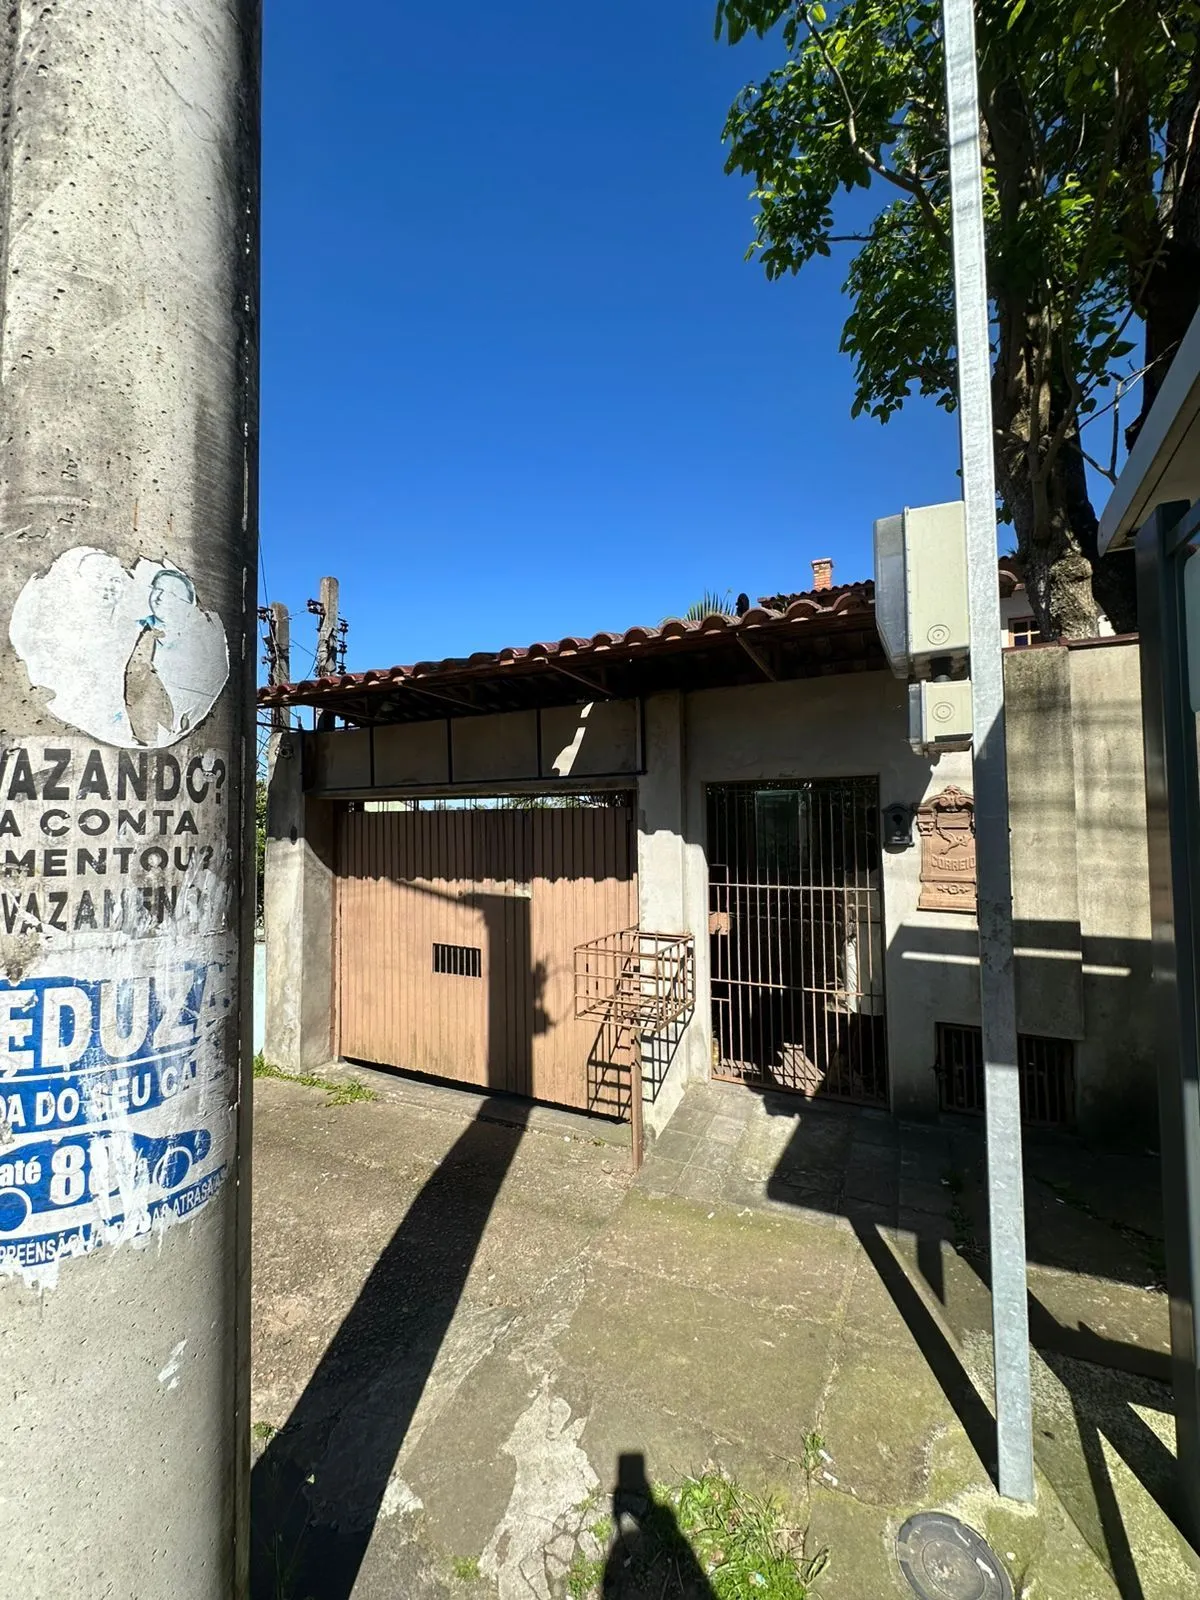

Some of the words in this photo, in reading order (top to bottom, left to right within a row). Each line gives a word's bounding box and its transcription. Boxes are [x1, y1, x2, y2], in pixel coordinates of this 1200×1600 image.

[0, 809, 21, 837] A
[40, 808, 199, 837] CONTA
[35, 1087, 80, 1126] DO
[90, 1073, 151, 1117] SEU
[0, 1156, 41, 1187] até
